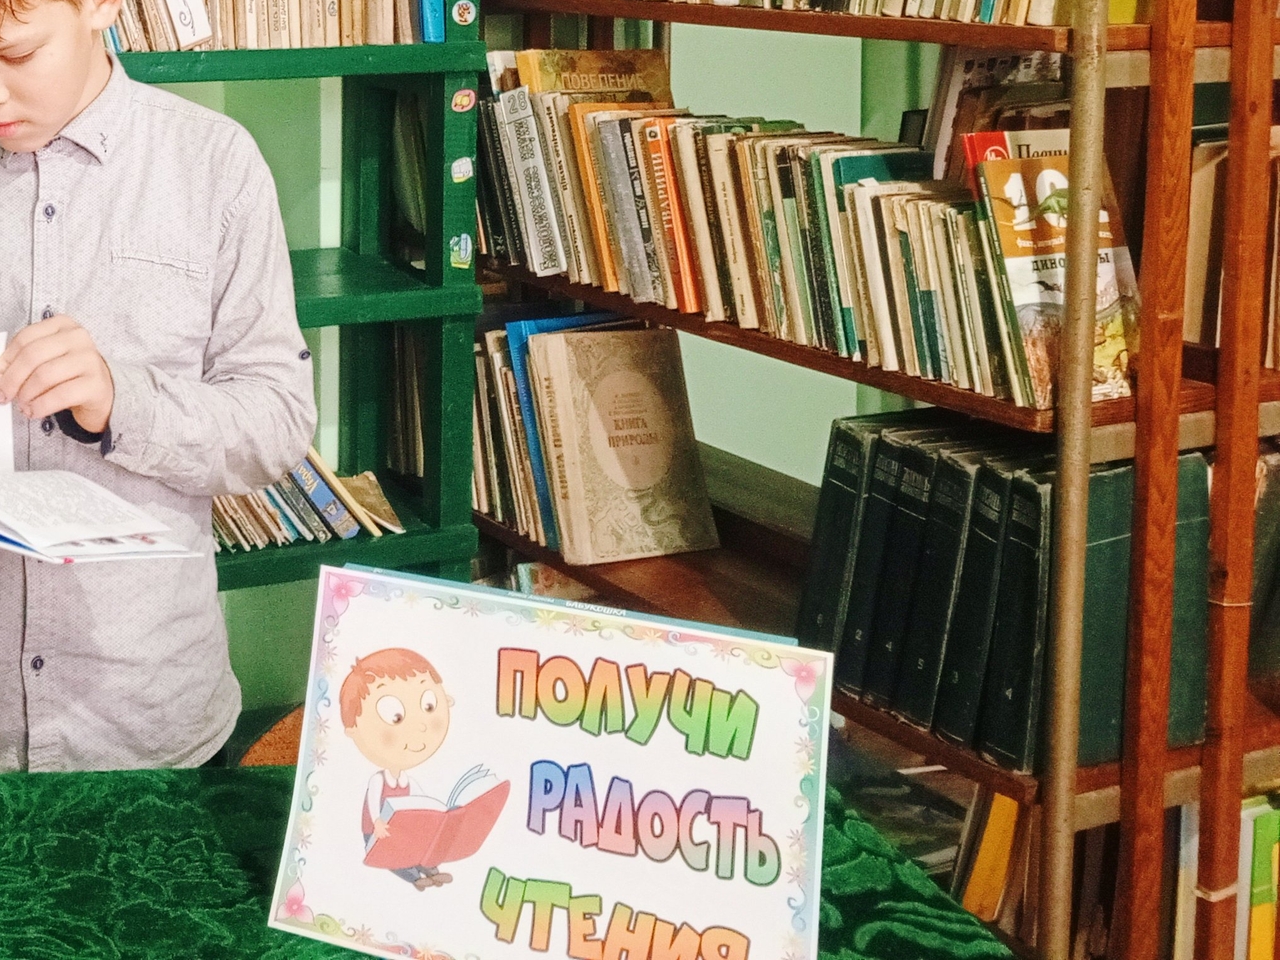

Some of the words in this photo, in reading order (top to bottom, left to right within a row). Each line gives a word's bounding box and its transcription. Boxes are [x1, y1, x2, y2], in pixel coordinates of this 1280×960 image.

[271, 11, 279, 31] ОЛЕСЬ
[560, 73, 643, 89] ПОВЕДЕНИЕ
[506, 90, 526, 114] 28
[651, 151, 673, 232] ТВАРИНИ
[614, 417, 648, 431] КНИГА
[608, 432, 661, 448] ПРИРОДЫ
[565, 600, 627, 616] БАБУКОШКА
[494, 645, 761, 762] ПОЛУЧИ
[526, 758, 781, 887] РАДОСТЬ
